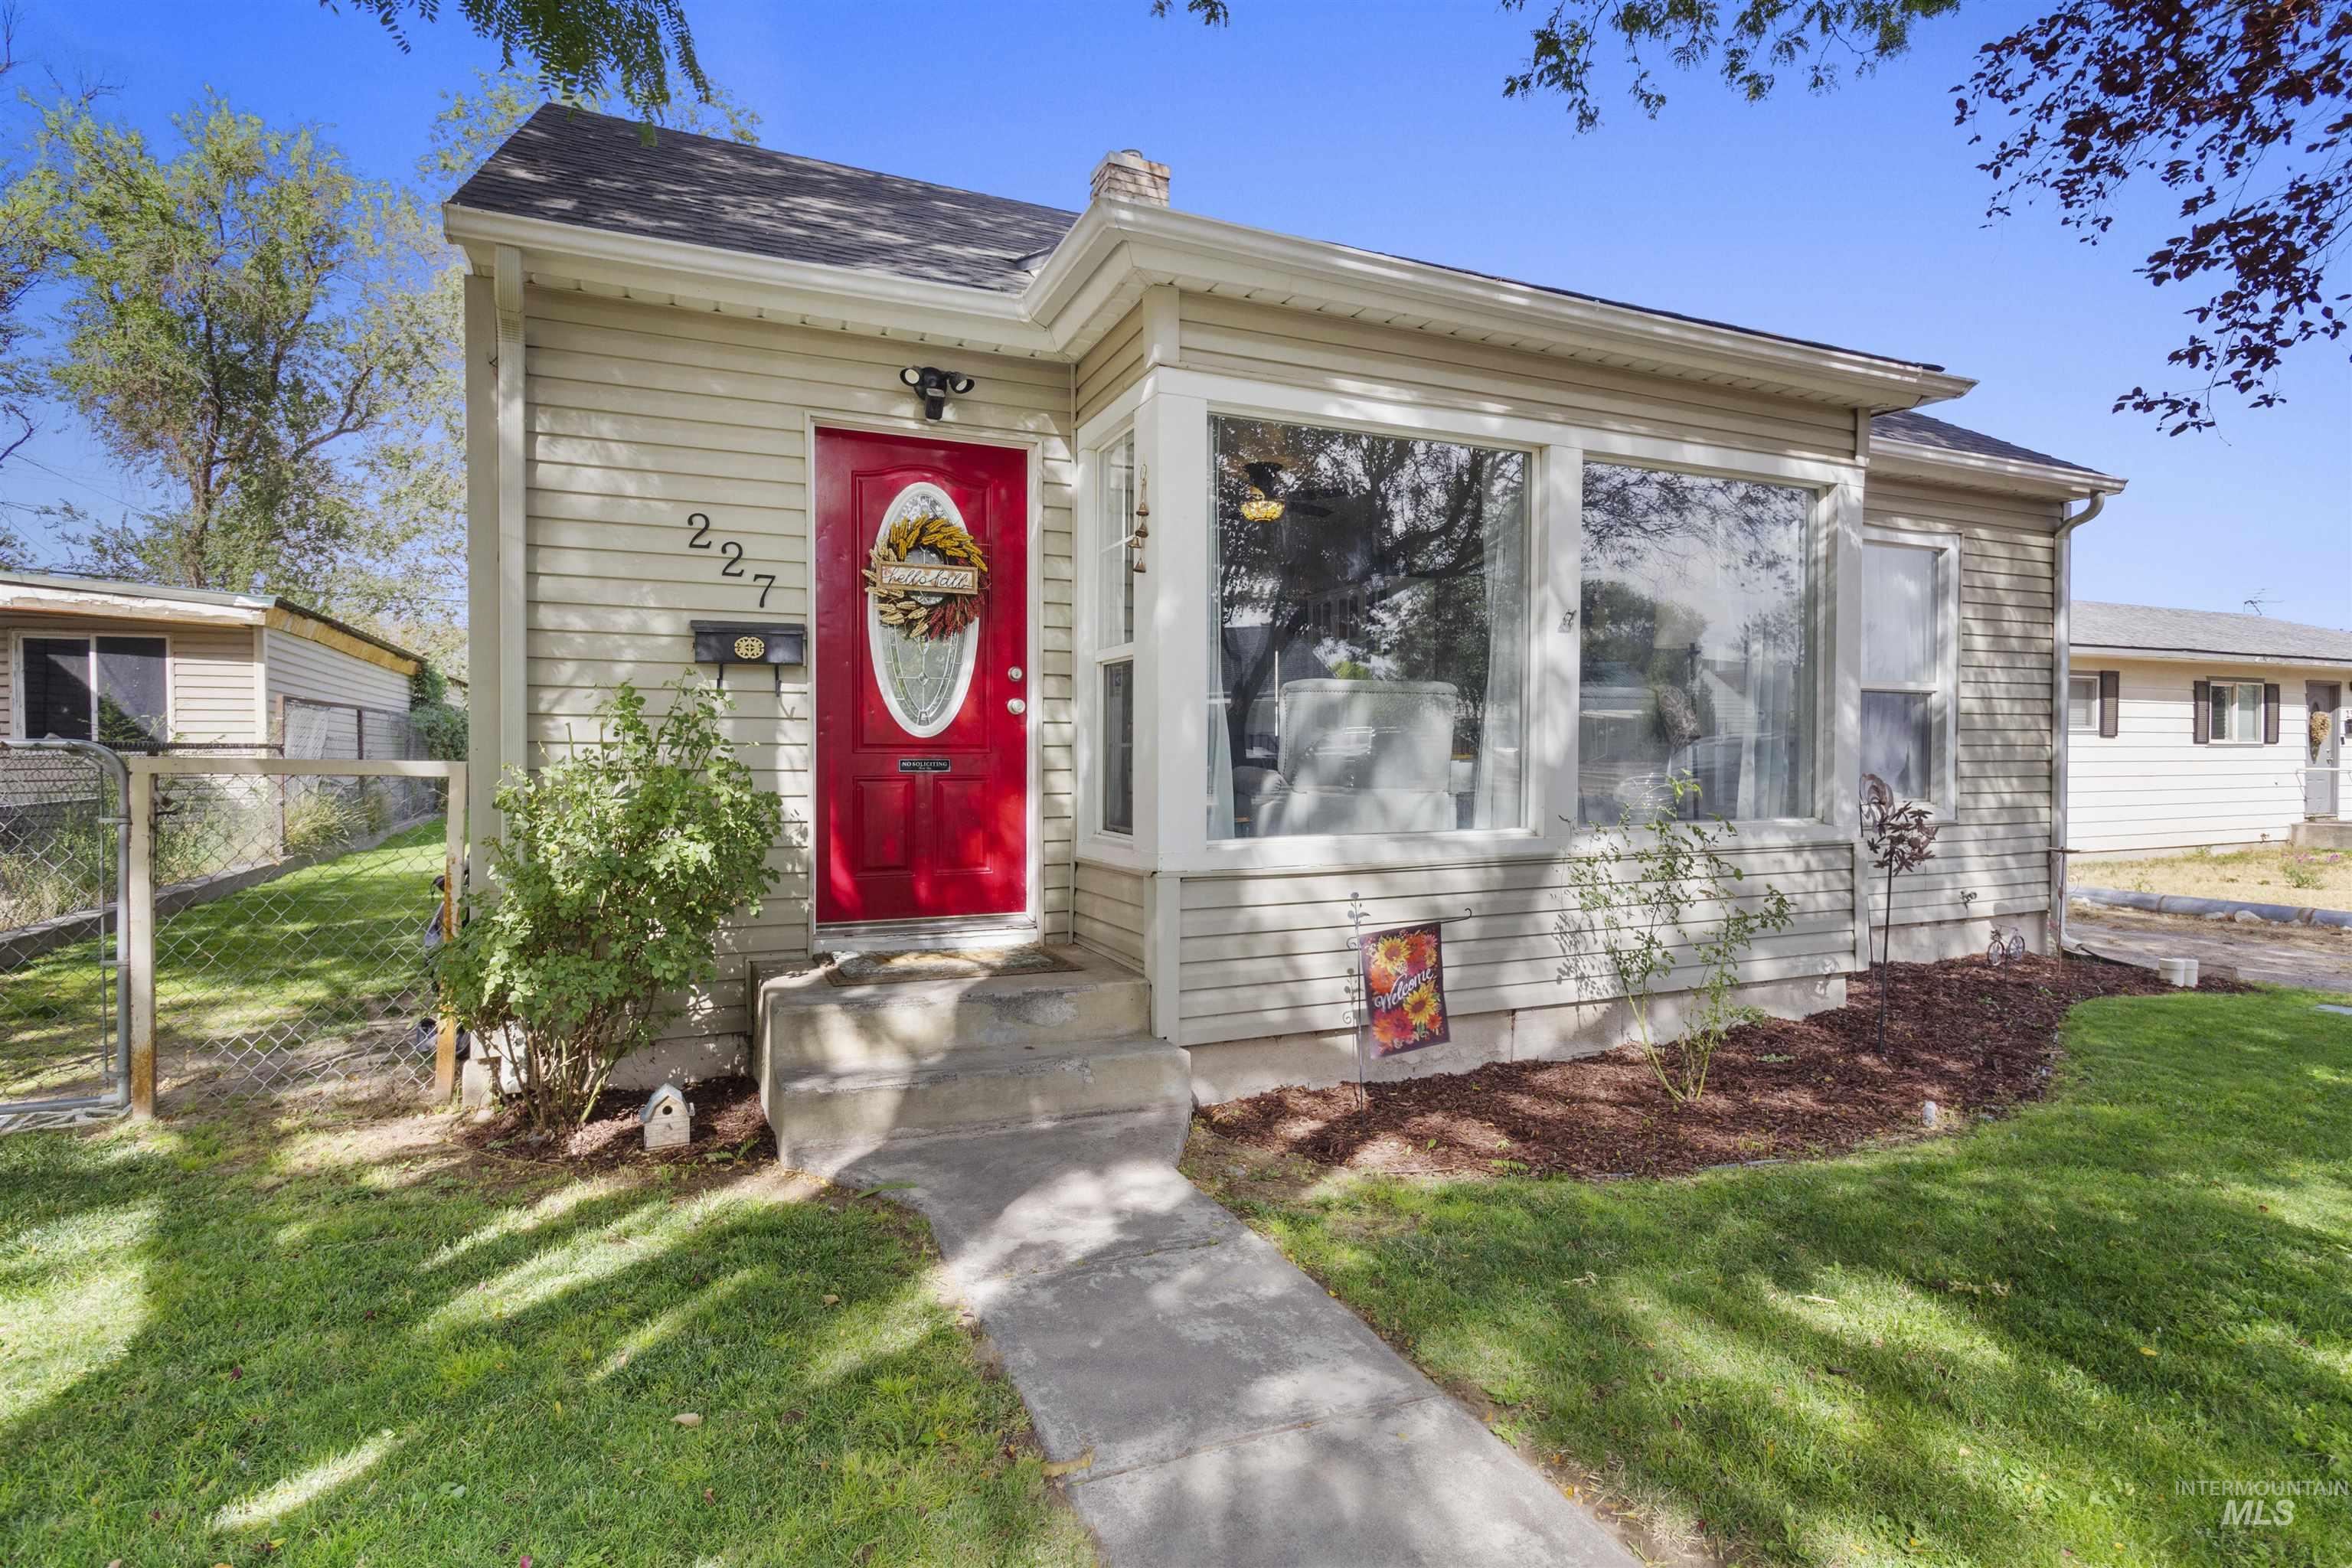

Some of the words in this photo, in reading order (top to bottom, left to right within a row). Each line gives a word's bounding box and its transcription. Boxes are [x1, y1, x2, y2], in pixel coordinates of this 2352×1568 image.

[688, 512, 776, 608] 227
[884, 566, 927, 586] hello
[929, 569, 972, 589] fall
[1374, 968, 1434, 1012] Welcome
